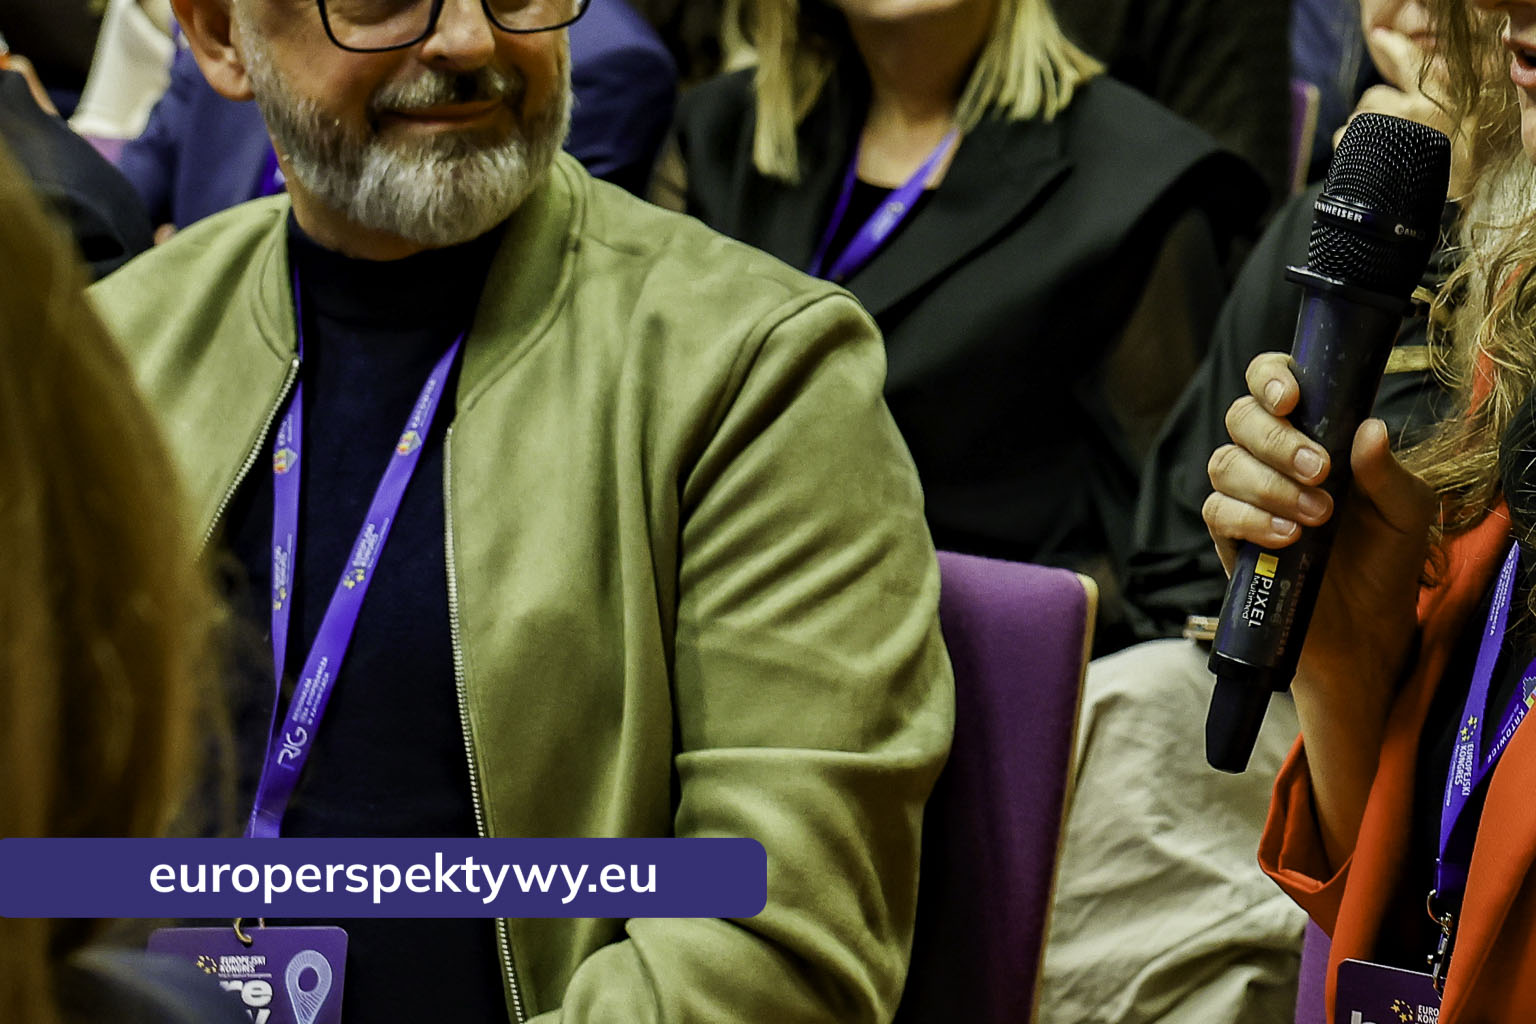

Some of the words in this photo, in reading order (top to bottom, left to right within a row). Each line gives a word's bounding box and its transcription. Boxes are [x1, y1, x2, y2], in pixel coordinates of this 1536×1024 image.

[1247, 576, 1274, 628] PIXEL
[1454, 744, 1468, 786] KONGRES
[1461, 743, 1475, 796] EUROPEJSKI
[1418, 1004, 1440, 1017] EURO
